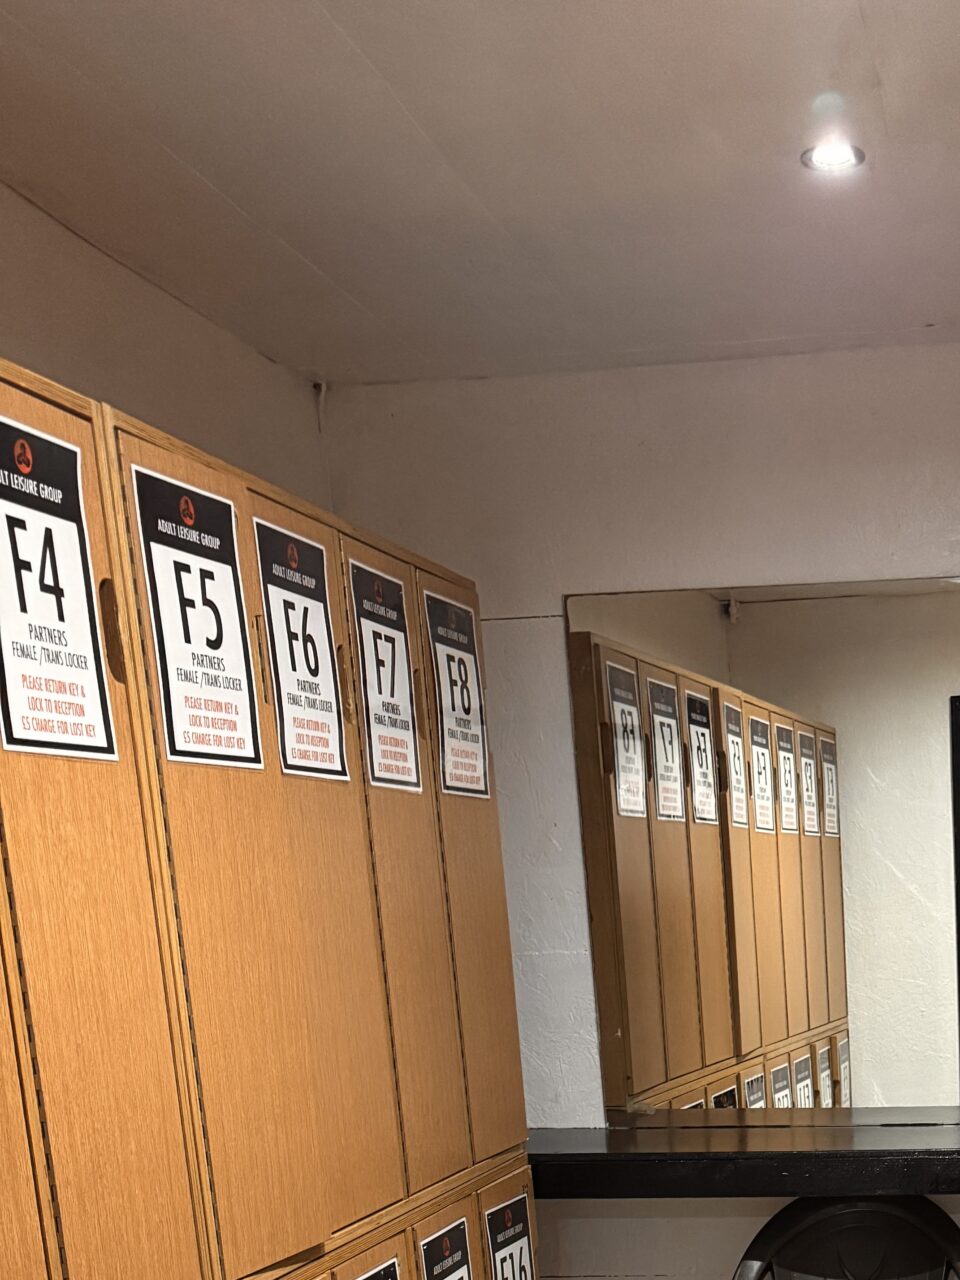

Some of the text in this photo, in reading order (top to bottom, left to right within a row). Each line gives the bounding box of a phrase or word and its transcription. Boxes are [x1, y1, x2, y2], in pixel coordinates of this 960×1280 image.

[10, 476, 38, 496] LEISURE
[39, 483, 62, 504] GROUP
[157, 518, 221, 550] ADULT LEISURE GROUP
[5, 514, 65, 622] F4
[172, 559, 224, 651] F5
[28, 624, 68, 647] PARTNERS
[282, 599, 319, 677] F6
[12, 641, 37, 661] FEMALE
[65, 652, 88, 670] LOCKER
[191, 651, 226, 672] PARTNERS
[372, 630, 395, 698] F7
[176, 667, 199, 685] FEMALE
[221, 676, 243, 692] LOCKER
[446, 653, 471, 716] F8
